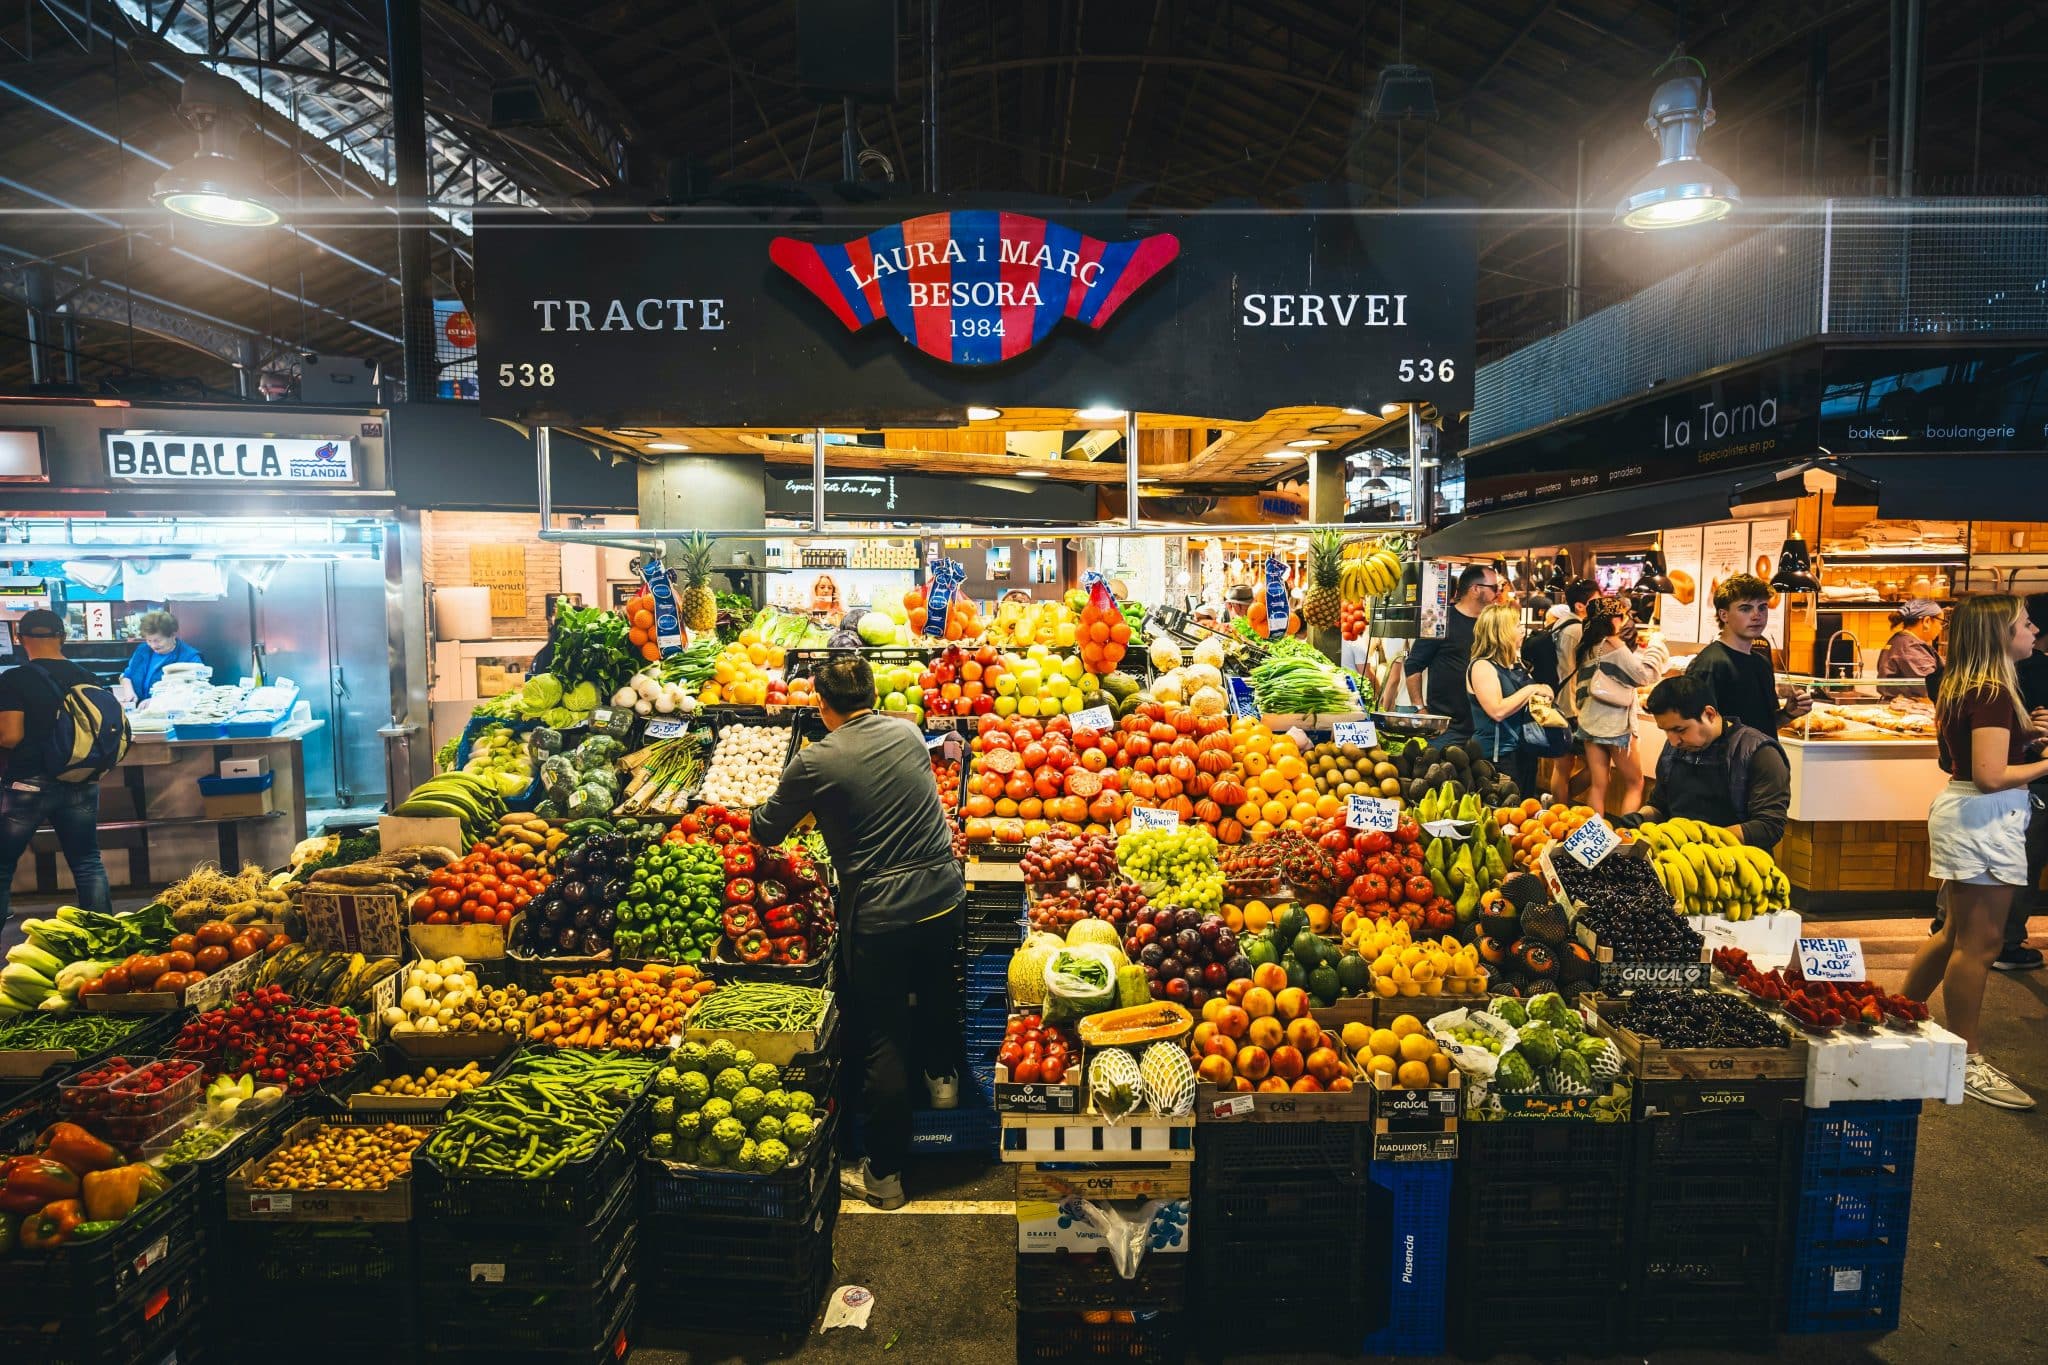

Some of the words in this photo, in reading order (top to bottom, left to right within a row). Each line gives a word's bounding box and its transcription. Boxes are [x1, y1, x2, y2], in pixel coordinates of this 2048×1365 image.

[845, 239, 967, 290] LAURA
[977, 238, 986, 262] i
[998, 238, 1105, 288] MARC
[908, 281, 1045, 307] BESORA
[533, 299, 725, 331] TRACTE
[1242, 294, 1408, 327] SERVEI
[949, 318, 1006, 337] 1984
[499, 363, 555, 387] 538
[1398, 358, 1454, 383] 536
[1664, 415, 1690, 449] La
[1700, 397, 1778, 441] Torna
[1848, 425, 1901, 441] bakery
[1926, 424, 2016, 441] boulangerie
[1763, 439, 1776, 453] pa
[112, 440, 282, 477] BACALLA
[289, 467, 348, 478] ISLANDIA
[859, 482, 882, 497] Lugo
[1563, 820, 1597, 852] CEREZA
[1799, 938, 1848, 953] FRESA
[1622, 968, 1683, 981] GRUCAL
[1010, 1094, 1047, 1104] GRUCAL
[1393, 1101, 1429, 1109] GRUCAL
[912, 1134, 953, 1143] Plasencia
[1379, 1143, 1427, 1152] MADUIXOTS
[1087, 1178, 1114, 1189] CASI
[1402, 1234, 1415, 1284] Plasencia
